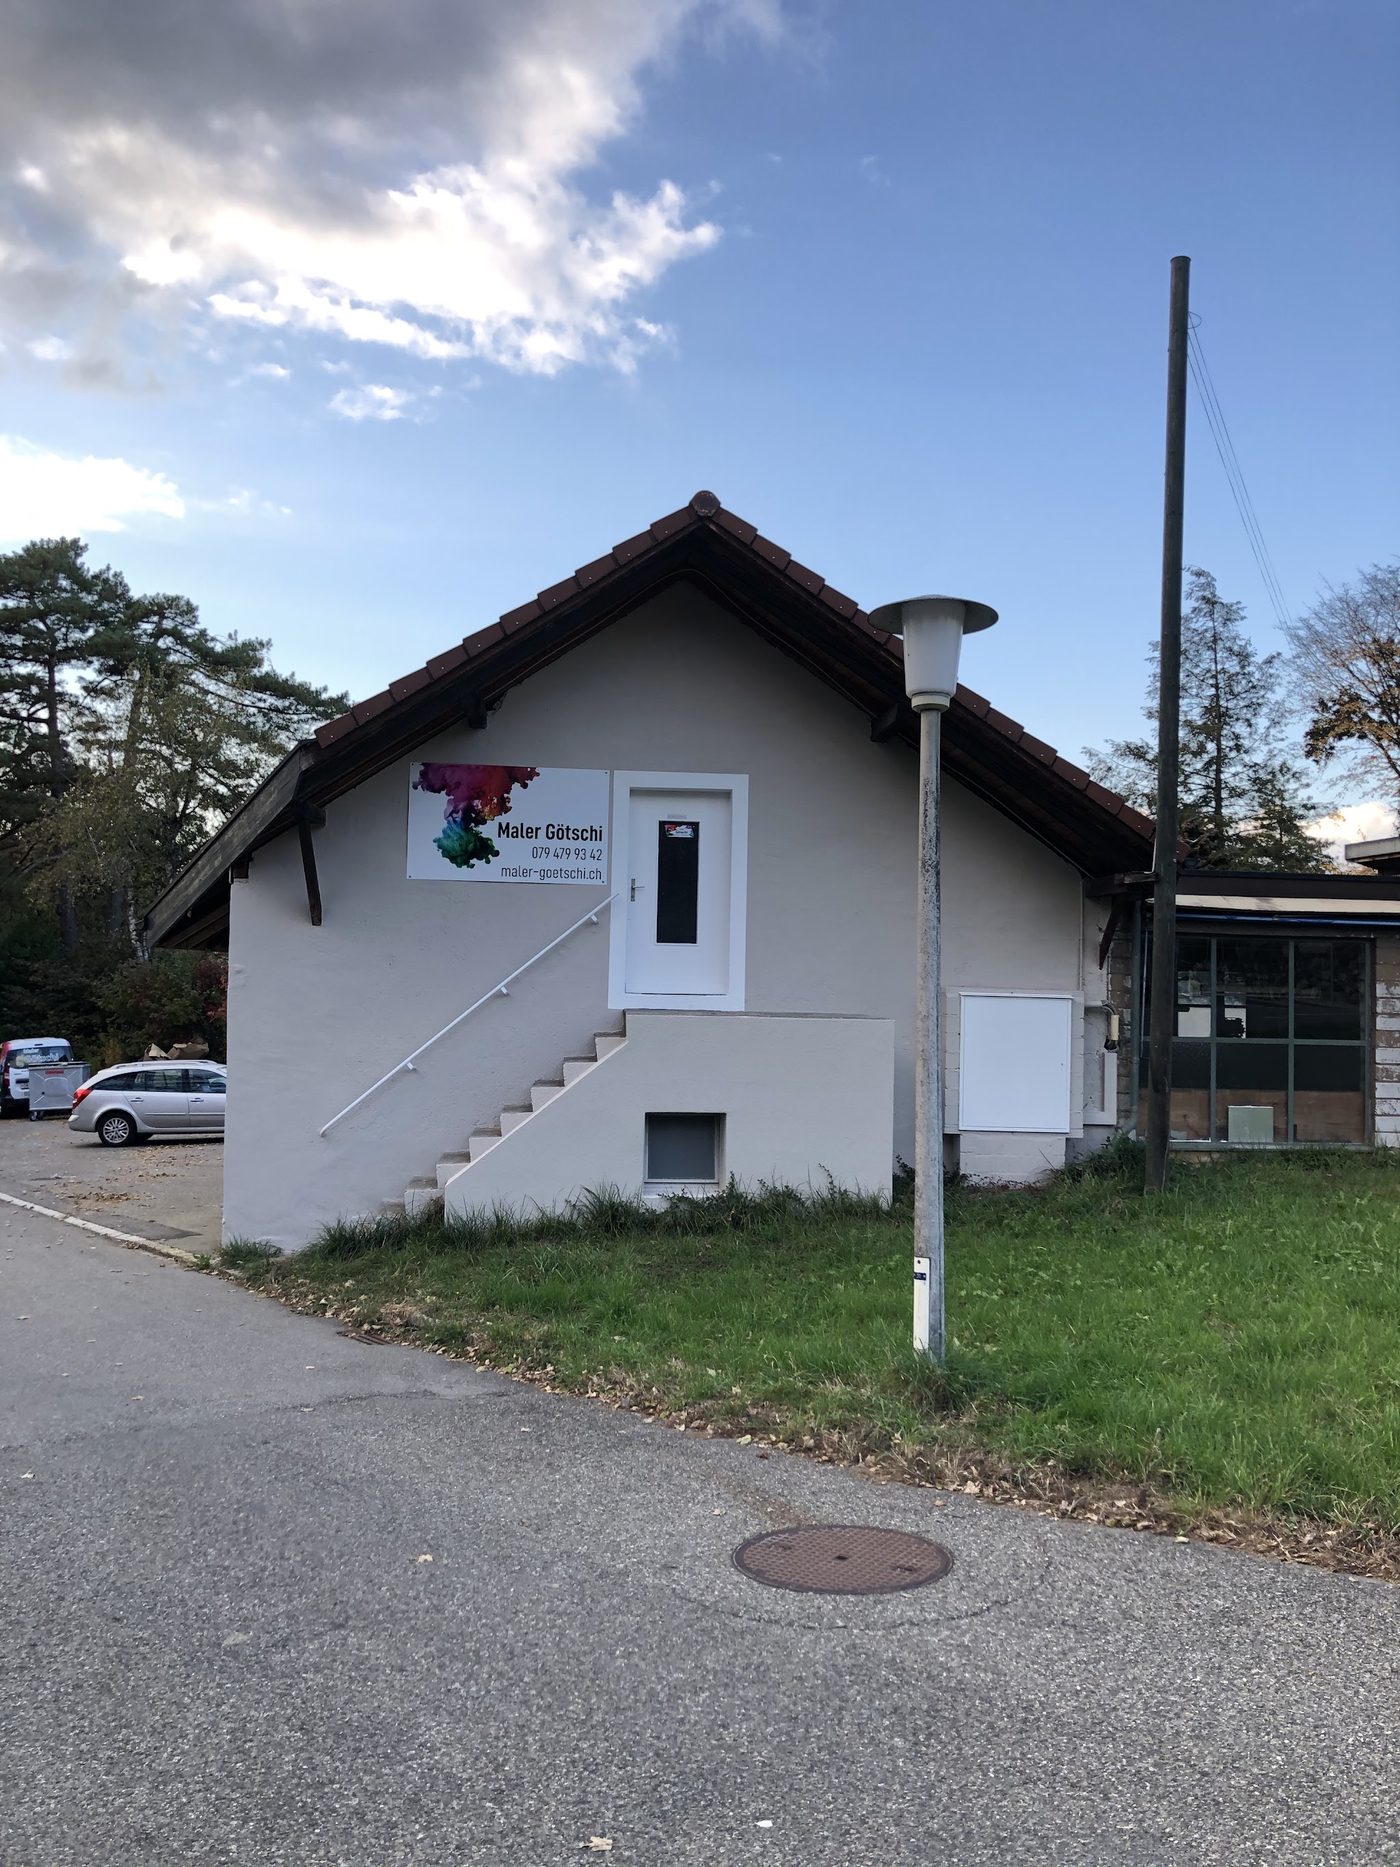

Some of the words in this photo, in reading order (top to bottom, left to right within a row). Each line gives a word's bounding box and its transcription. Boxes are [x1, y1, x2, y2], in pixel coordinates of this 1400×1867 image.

[498, 822, 541, 839] Maler
[546, 823, 603, 842] Götschi
[532, 846, 550, 859] 079
[553, 847, 571, 860] 479
[574, 847, 587, 861] 93
[590, 848, 603, 861] 42
[501, 865, 602, 880] maler-goetschi.ch
